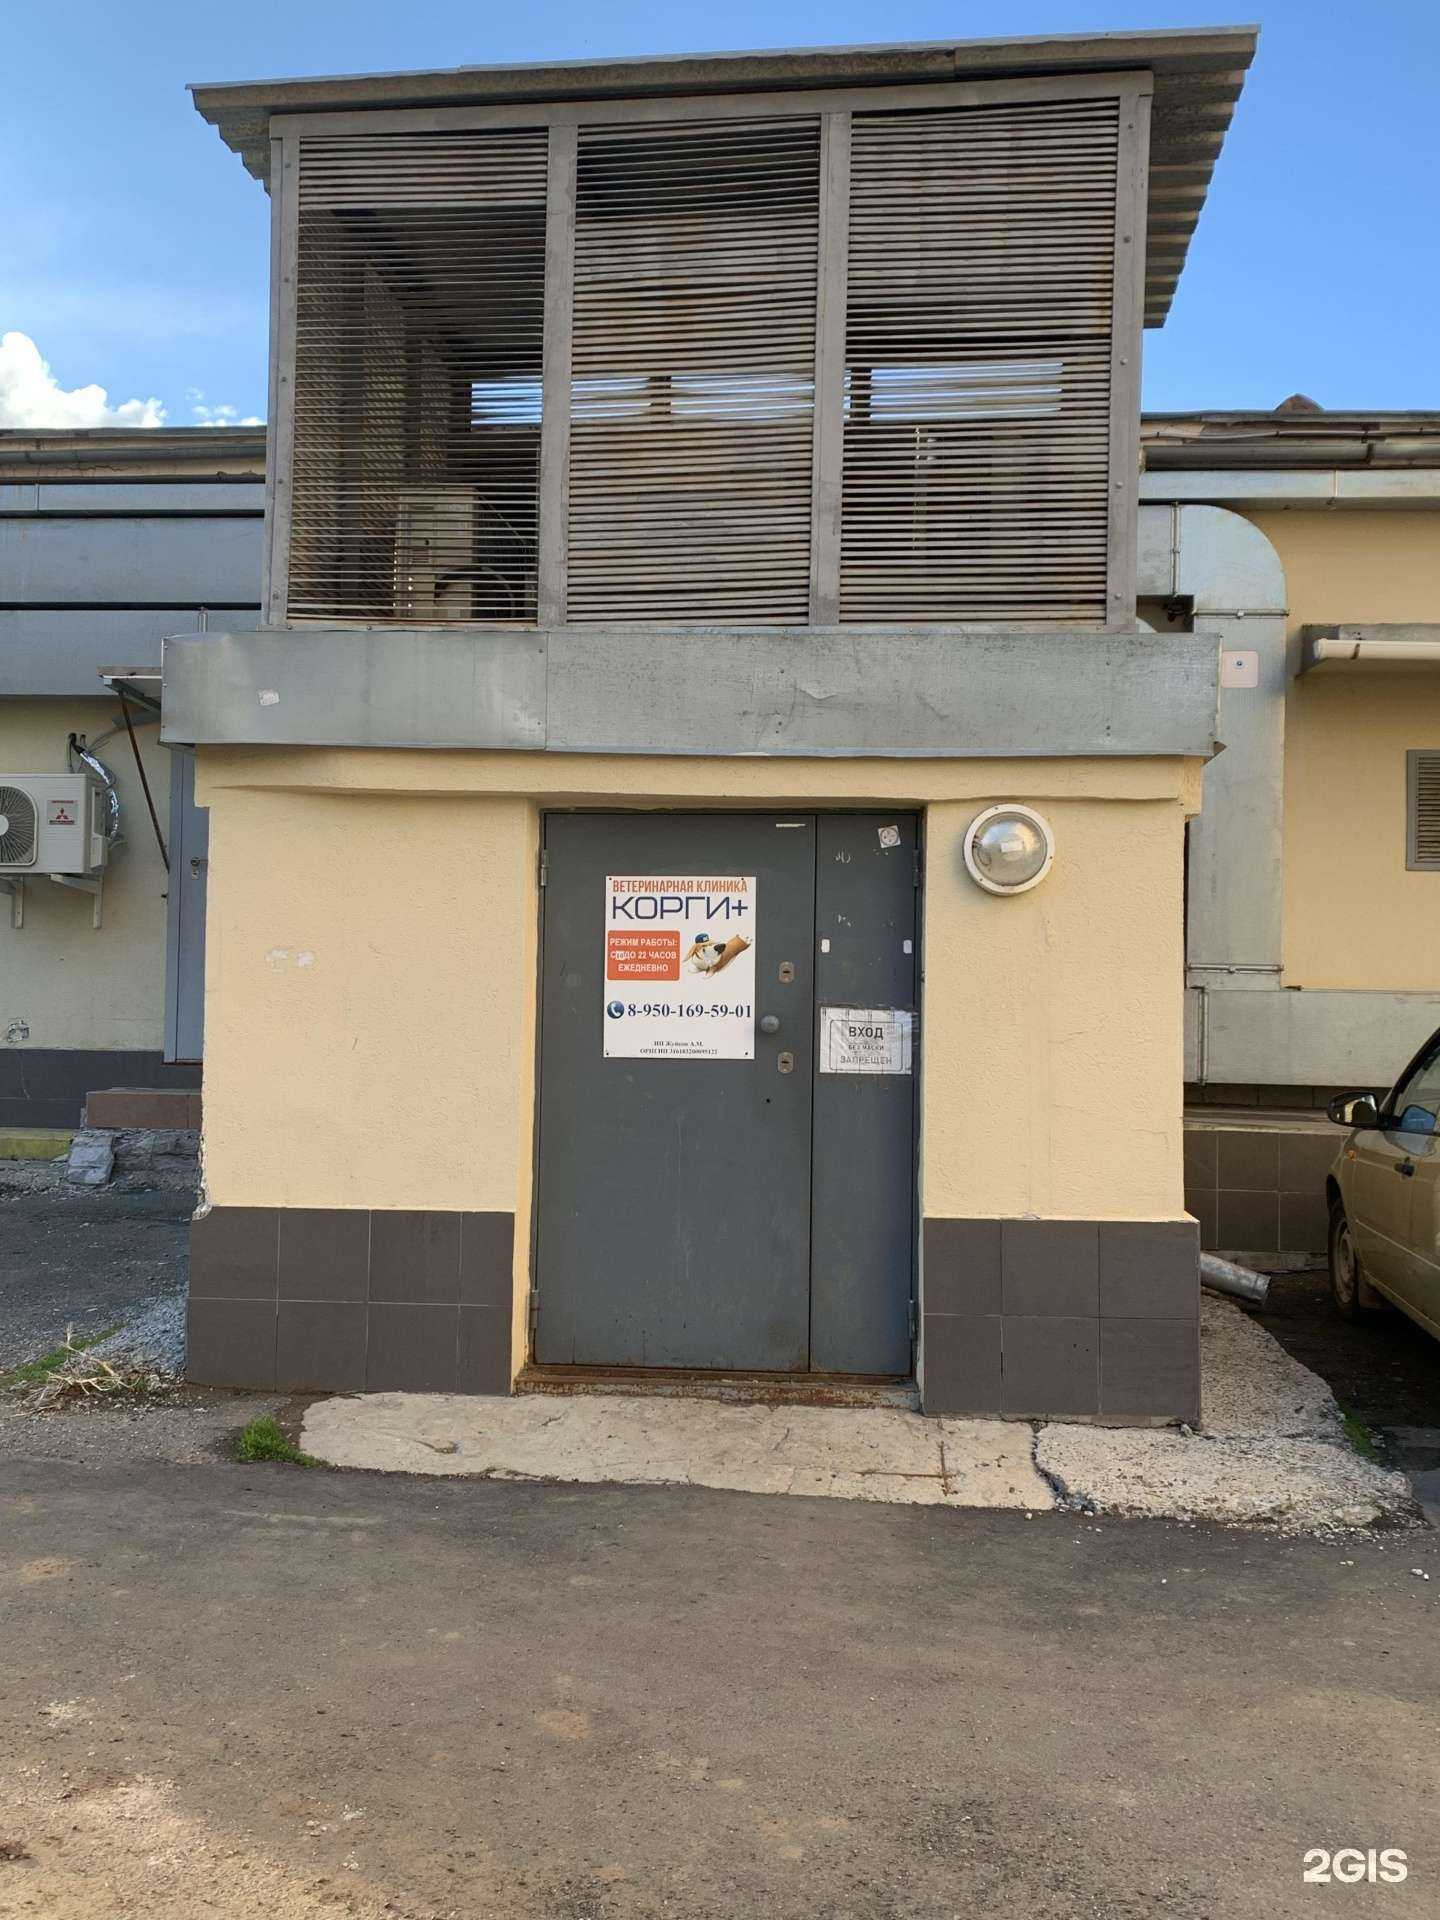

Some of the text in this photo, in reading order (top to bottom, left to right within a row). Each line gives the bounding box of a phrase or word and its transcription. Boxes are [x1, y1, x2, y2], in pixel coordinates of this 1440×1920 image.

[613, 879, 748, 893] ВЕТЕРИНАРНАЯ КЛИНИКА
[612, 896, 748, 920] КОРГИ+
[609, 937, 639, 947] РЕЖИМ
[625, 951, 637, 960] ДО
[638, 951, 647, 960] 22
[648, 951, 677, 960] ЧАСОВ
[618, 963, 669, 973] ЕЖЕДНЕВНО
[627, 1004, 752, 1018] 8-950-169-59-01
[848, 1026, 884, 1040] ВХОД
[840, 1055, 892, 1065] ЗАПРЕЩЕН
